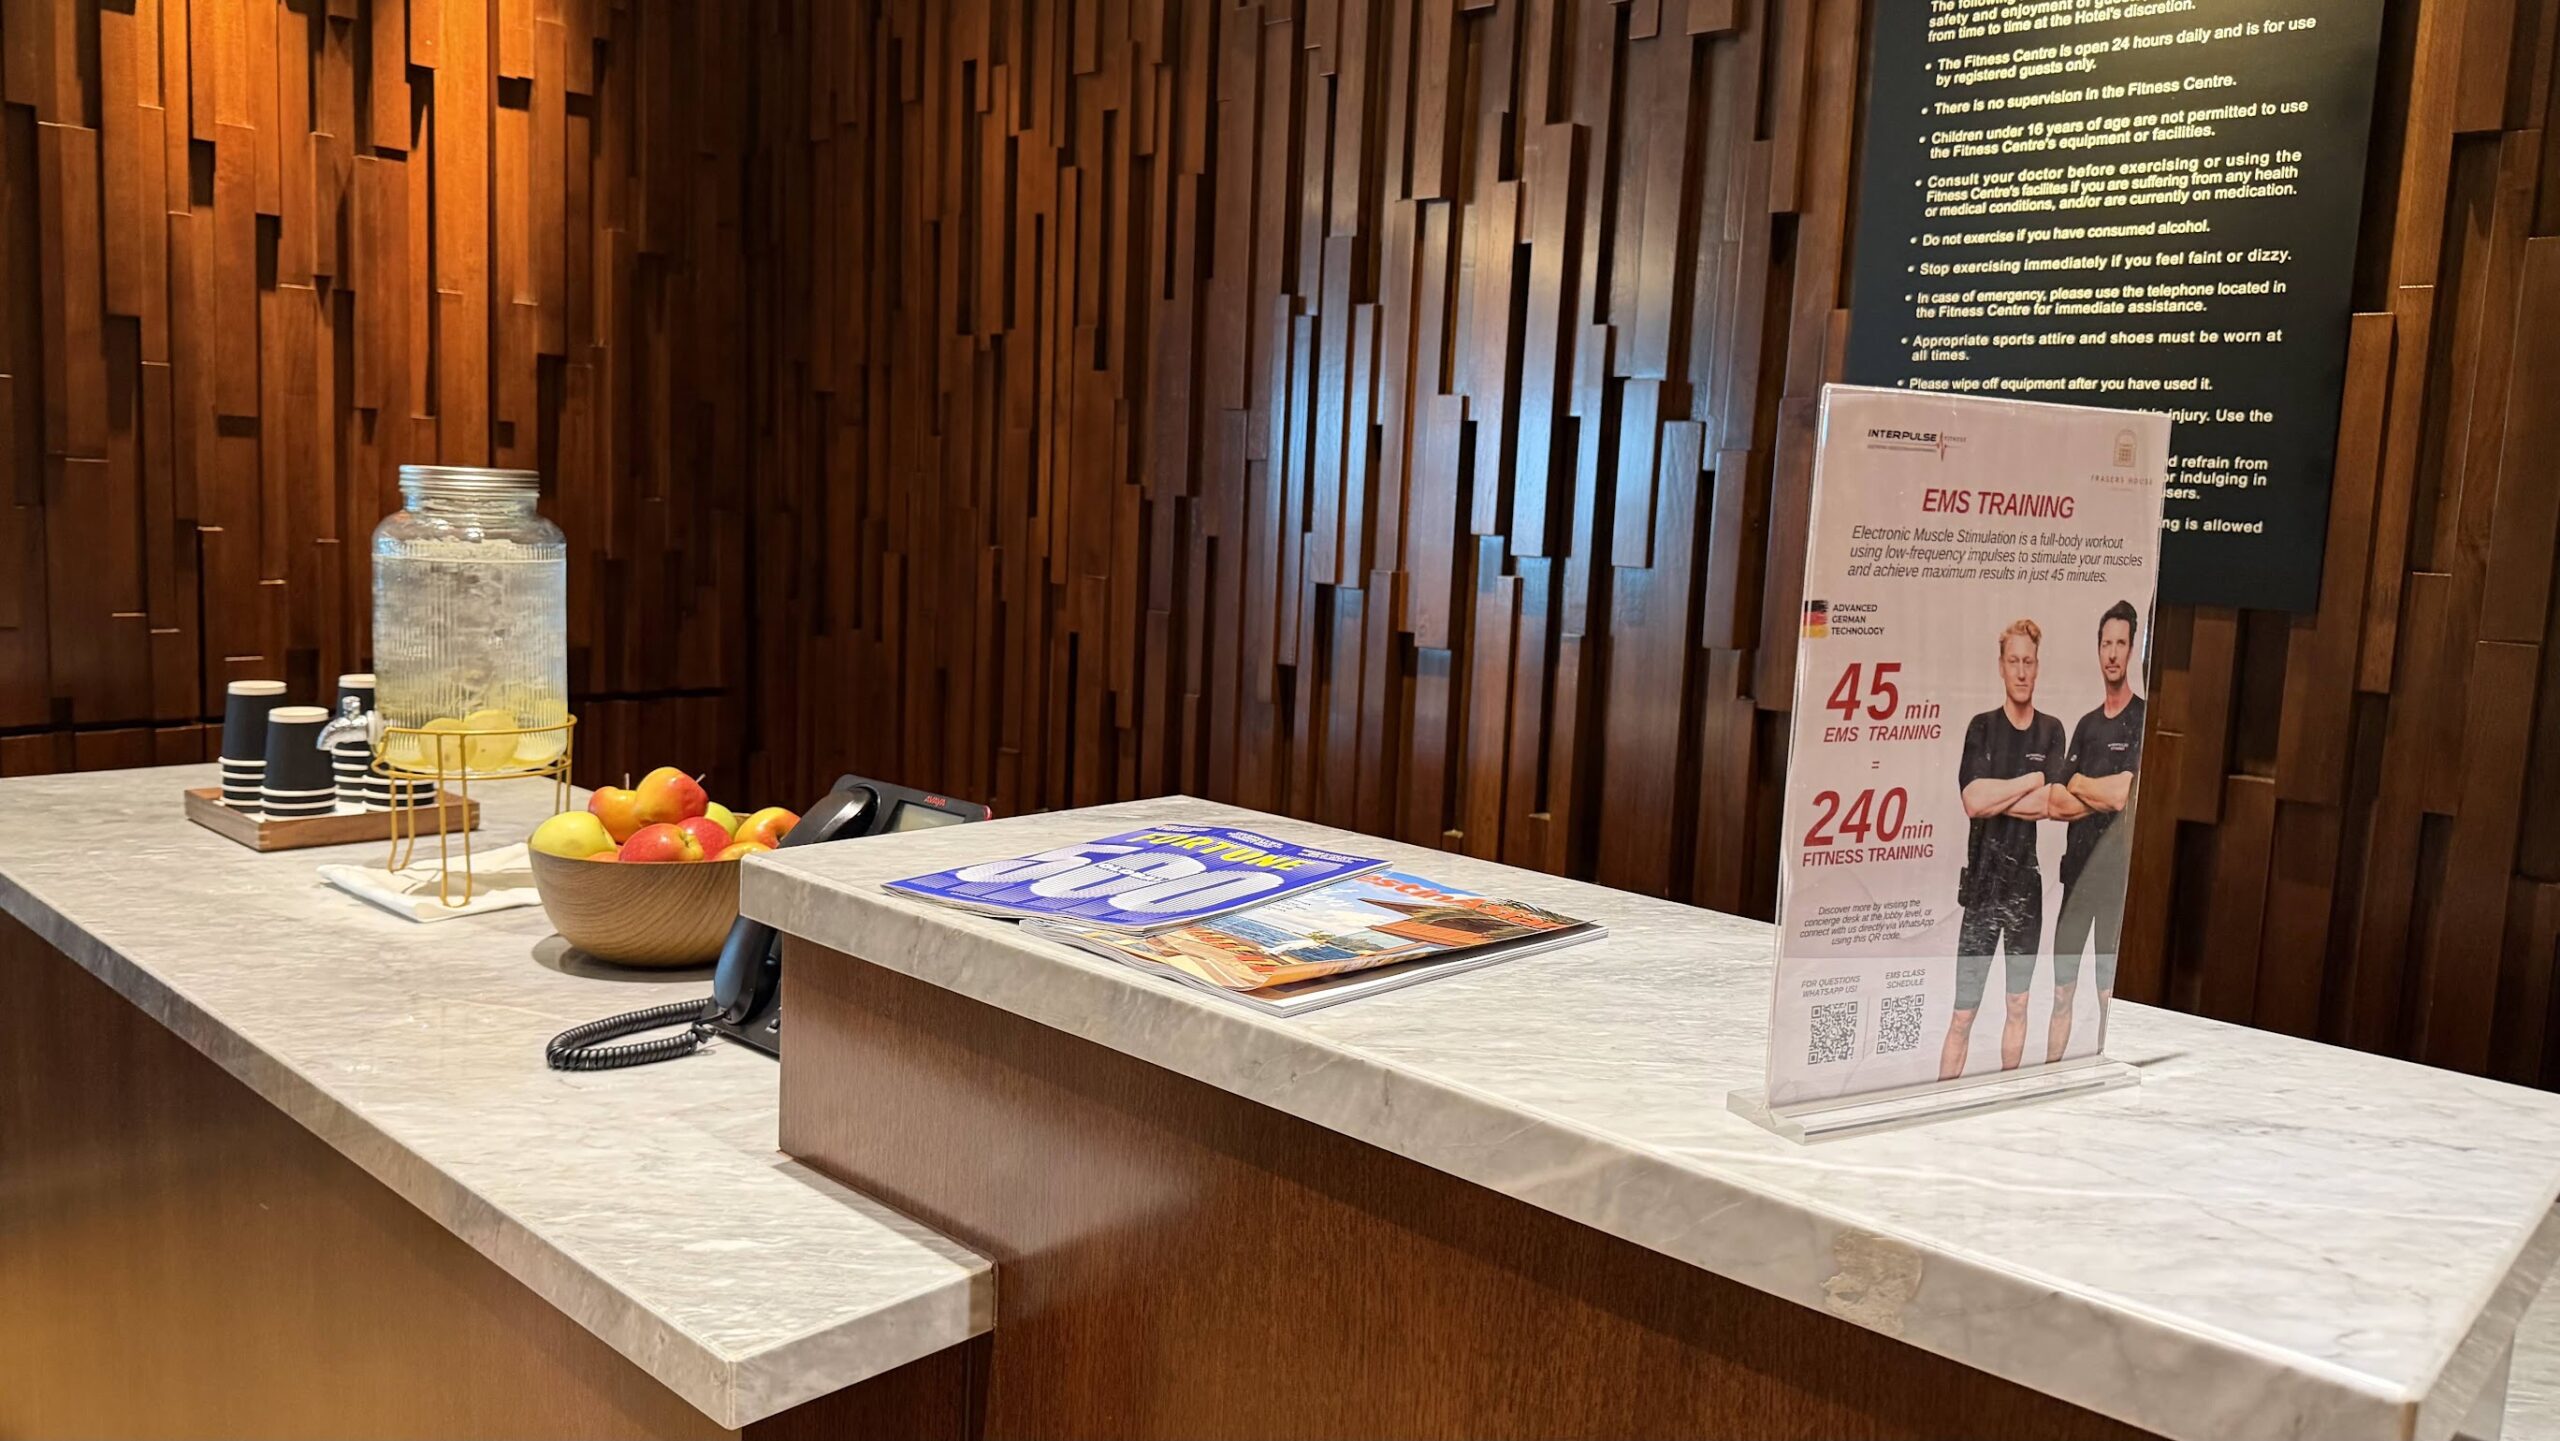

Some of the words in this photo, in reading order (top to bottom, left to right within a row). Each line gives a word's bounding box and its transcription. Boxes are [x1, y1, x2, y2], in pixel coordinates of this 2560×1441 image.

[1938, 58, 1962, 71] The
[1964, 53, 2010, 68] Fitness
[2012, 47, 2058, 62] Centre
[2059, 44, 2072, 57] is
[2074, 41, 2110, 59] open
[2111, 36, 2130, 52] 24
[2132, 34, 2174, 49] hours
[2176, 28, 2212, 44] daily
[2214, 23, 2243, 39] and
[2246, 22, 2260, 36] is
[2263, 19, 2285, 34] for
[2288, 17, 2316, 30] use
[1936, 74, 1952, 88] by
[1954, 64, 2017, 86] registered
[2019, 60, 2063, 80] guests
[2065, 55, 2097, 73] only.
[1934, 102, 1971, 115] There
[1973, 99, 1985, 112] is
[1987, 98, 2005, 110] no
[2007, 89, 2083, 110] supervision
[2085, 87, 2099, 100] in
[2102, 85, 2125, 99] the
[2128, 80, 2180, 96] Fitness
[2183, 75, 2237, 90] Centre.
[1931, 130, 1984, 144] Children
[1986, 125, 2024, 140] under
[2027, 122, 2044, 136] 16
[2045, 121, 2084, 139] years
[2086, 116, 2102, 131] of
[2103, 117, 2131, 132] age
[2133, 114, 2158, 127] are
[2160, 110, 2185, 124] not
[2187, 102, 2257, 126] permitted
[2261, 102, 2276, 115] to
[2280, 101, 2308, 114] use
[1930, 146, 1950, 159] the
[1953, 144, 1999, 157] Fitness
[2002, 135, 2057, 153] Centre's
[2058, 129, 2132, 150] equipment
[2133, 130, 2150, 142] or
[2152, 123, 2216, 141] facilities.
[1922, 234, 1941, 246] Do
[1942, 233, 1962, 245] not
[1963, 230, 2015, 244] exercise
[2016, 228, 2027, 242] if
[2025, 230, 2051, 244] you
[2053, 227, 2086, 240] have
[2087, 222, 2156, 238] consumed
[2157, 219, 2210, 234] alcohol.
[1920, 262, 1950, 277] Stop
[1952, 259, 2021, 274] exercising
[2024, 255, 2108, 271] immediately
[2111, 254, 2122, 268] if
[2124, 256, 2152, 270] you
[2156, 252, 2184, 266] feel
[2188, 250, 2222, 264] faint
[2226, 252, 2244, 263] or
[2247, 248, 2292, 264] dizzy.
[1917, 292, 1930, 304] In
[1931, 292, 1960, 304] case
[1962, 290, 1976, 302] of
[1976, 290, 2047, 306] emergency,
[2049, 287, 2093, 304] please
[2095, 288, 2120, 299] use
[2122, 285, 2145, 298] the
[2147, 283, 2215, 302] telephone
[2217, 280, 2270, 295] located
[2273, 280, 2286, 293] in
[1916, 306, 1936, 318] the
[1938, 305, 1984, 318] Fitness
[1987, 301, 2031, 316] Centre
[2033, 300, 2054, 315] for
[2054, 301, 2125, 315] immediate
[2128, 297, 2207, 313] assistance.
[1909, 378, 1950, 390] Please
[1952, 378, 1981, 392] wipe
[1982, 377, 2000, 390] off
[2000, 377, 2066, 392] equipment
[2068, 377, 2099, 390] after
[2100, 379, 2125, 392] you
[2128, 377, 2161, 390] have
[2164, 377, 2198, 390] used
[2200, 377, 2213, 390] it.
[2216, 409, 2245, 422] Use
[2249, 409, 2273, 422] the
[1868, 429, 1937, 442] INTERPULSE
[2180, 470, 2248, 488] indulging
[2253, 473, 2267, 486] in
[1922, 488, 1972, 514] EMS
[1978, 491, 2074, 519] TRAINING
[2185, 517, 2198, 530] is
[2203, 519, 2263, 534] allowed
[1852, 525, 1911, 541] Electronic
[1913, 528, 1954, 542] Muscle
[1956, 529, 2016, 545] Stimulation
[2018, 531, 2028, 546] is
[2030, 535, 2037, 546] a
[2040, 532, 2084, 550] full-body
[2085, 535, 2124, 549] workout
[1850, 544, 1883, 562] using
[1884, 544, 1966, 565] low-frequency
[1967, 547, 2016, 565] impulses
[2018, 550, 2029, 563] to
[2030, 550, 2077, 564] stimulate
[2077, 554, 2102, 568] your
[2102, 553, 2143, 567] muscles
[1847, 562, 1872, 576] and
[1873, 563, 1919, 578] achieve
[1921, 564, 1977, 579] maximum
[1978, 566, 2016, 580] results
[2017, 566, 2028, 580] in
[2028, 567, 2050, 584] just
[2050, 568, 2065, 581] 45
[2066, 568, 2107, 582] minutes.
[1832, 604, 1878, 612] ADVANCED
[1832, 615, 1866, 624] GERMAN
[1831, 626, 1884, 635] TECHNOLOGY
[1826, 662, 1902, 720] 45
[1904, 699, 1940, 719] min
[1823, 726, 1859, 742] EMS
[1869, 724, 1942, 741] TRAINING
[1803, 787, 1908, 847] 240
[1902, 820, 1933, 839] min
[1126, 832, 1308, 873] FORTUNE
[1802, 849, 1863, 867] FITNESS
[1868, 844, 1933, 862] TRAINING
[955, 843, 1285, 914] 500
[1801, 979, 1818, 988] FOR
[1818, 975, 1861, 987] QUESTIONS
[1885, 970, 1902, 980] EMS
[1902, 968, 1926, 978] CLASS
[1886, 978, 1924, 989] SCHEDULE
